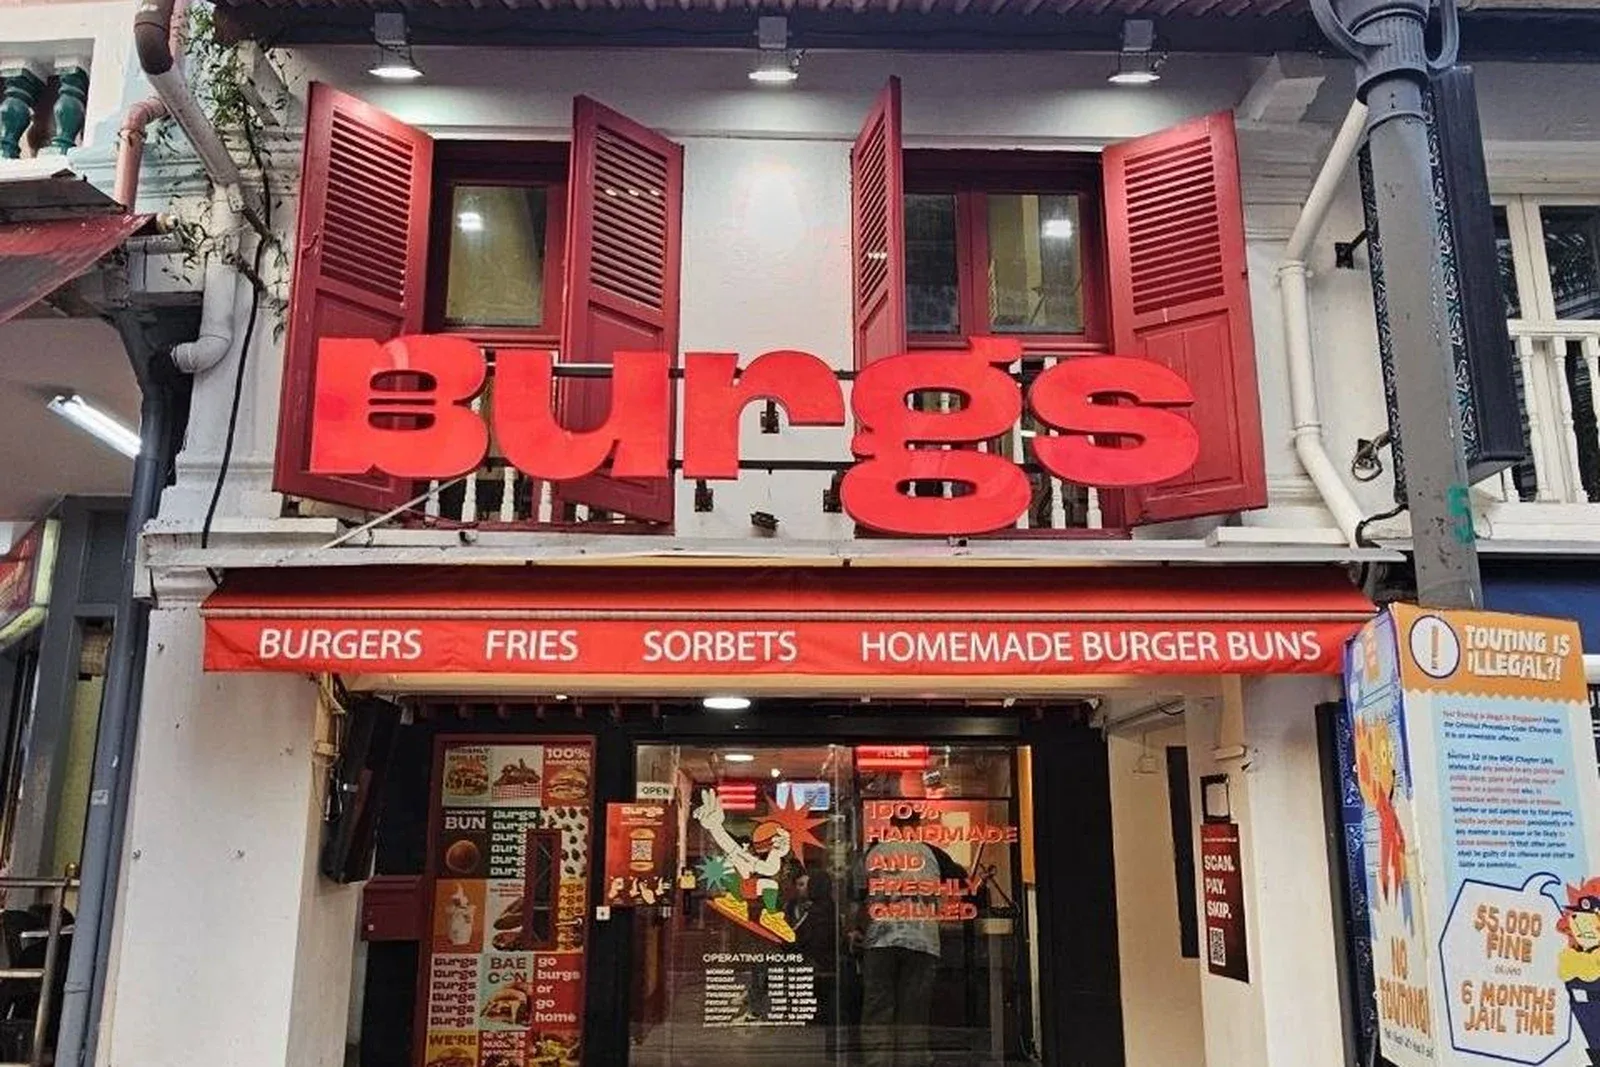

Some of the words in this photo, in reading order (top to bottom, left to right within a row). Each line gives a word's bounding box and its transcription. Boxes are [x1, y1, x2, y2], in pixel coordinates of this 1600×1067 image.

[309, 335, 1201, 535] Burgs
[258, 628, 423, 660] BURGERS
[485, 629, 579, 661] FRIES
[642, 630, 797, 662] SORBETS
[861, 631, 1074, 662] HOMEMADE
[1082, 631, 1221, 662] BURGER
[1227, 631, 1321, 662] BUNS
[1464, 624, 1546, 654] TOUTING
[1553, 633, 1571, 656] IS
[1466, 652, 1562, 681] ILLEGAL?!
[547, 748, 590, 760] 100%
[641, 787, 669, 796] OPEN
[865, 803, 942, 820] 100%
[445, 816, 486, 830] BUN
[867, 824, 1018, 844] HANDMADE
[868, 853, 926, 871] AND
[868, 876, 981, 896] FRESHLY
[868, 902, 978, 921] GRILLED
[1474, 904, 1542, 937] $5,000
[1486, 931, 1532, 963] FINE
[490, 957, 527, 969] BAE
[538, 957, 558, 967] go
[703, 954, 764, 963] OPERATING
[766, 954, 804, 962] HOURS
[1390, 936, 1407, 980] NO
[537, 969, 581, 981] burgs
[536, 984, 554, 993] or
[1462, 979, 1473, 1004] 6
[1480, 980, 1556, 1007] MONTHS
[535, 998, 555, 1009] go
[535, 1011, 577, 1022] home
[1464, 1005, 1507, 1033] JAIL
[1515, 1009, 1555, 1036] TIME
[429, 1034, 476, 1047] WE'RE
